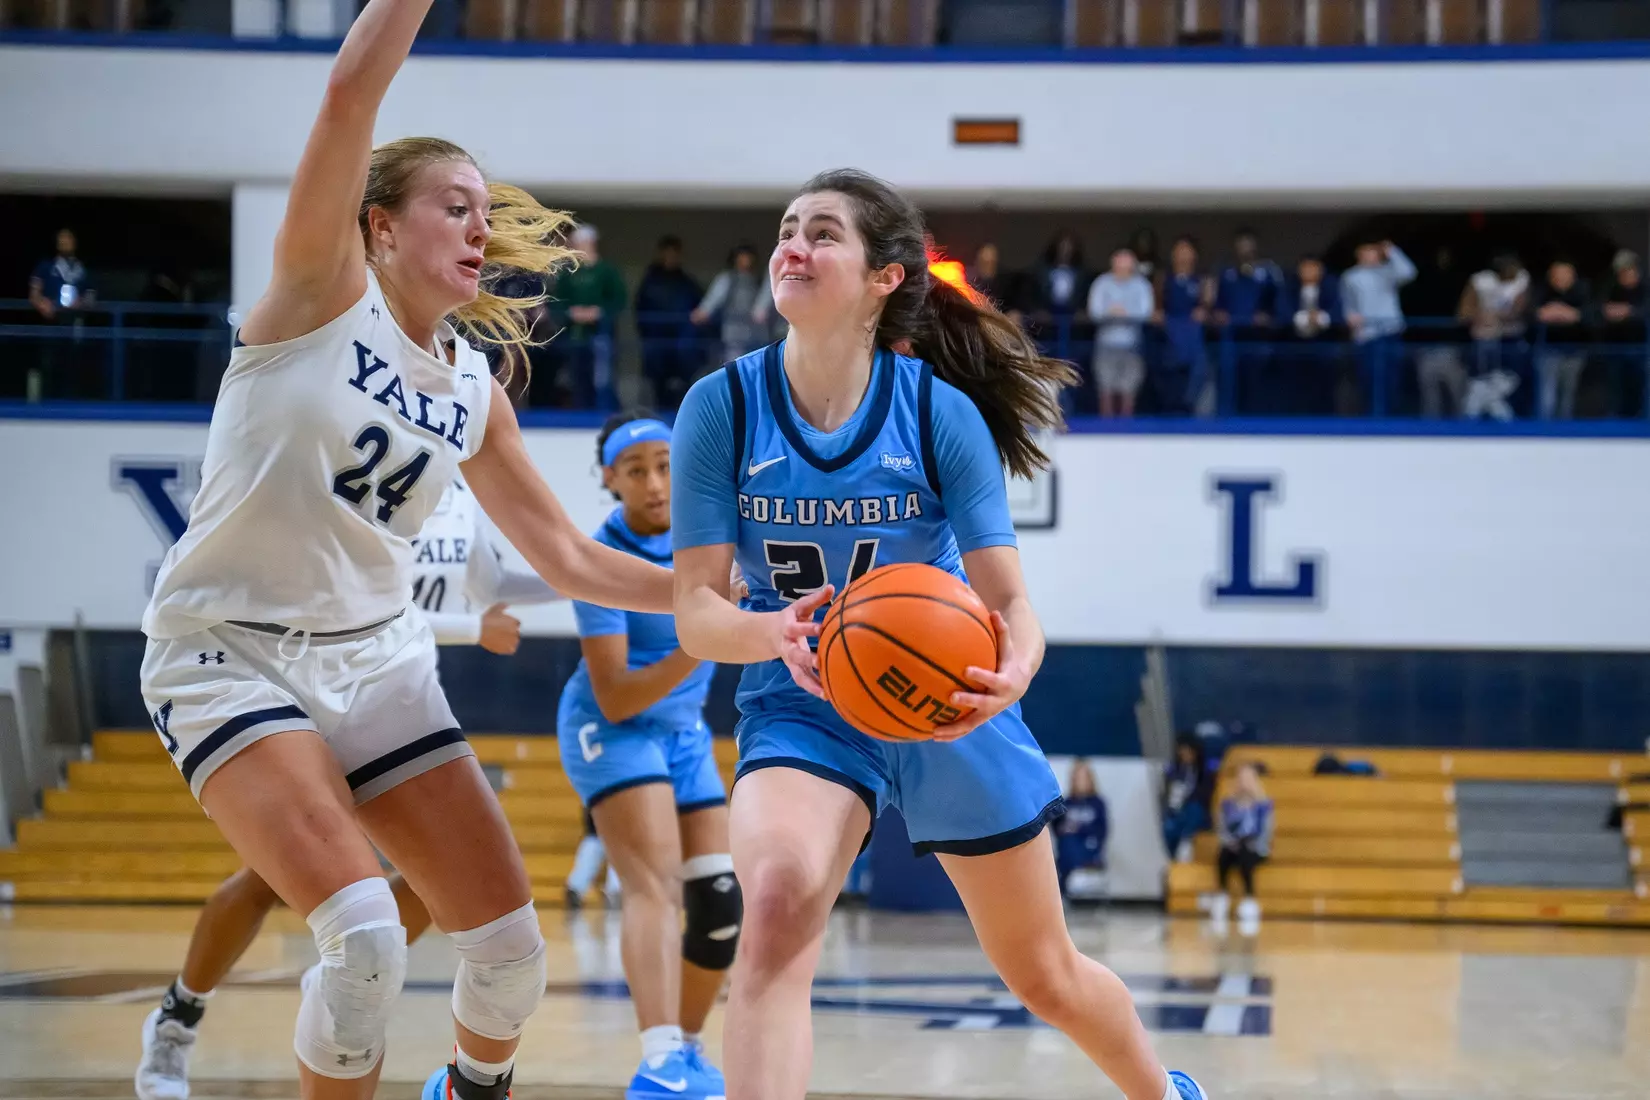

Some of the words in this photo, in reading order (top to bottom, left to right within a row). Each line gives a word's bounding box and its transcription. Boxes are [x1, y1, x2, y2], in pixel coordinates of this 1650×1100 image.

[347, 339, 469, 452] YALE
[331, 421, 434, 526] 24
[738, 491, 923, 526] COLUMBIA
[410, 537, 467, 563] ALE
[1202, 468, 1328, 611] L
[876, 664, 961, 726] ELITE
[152, 698, 180, 757] Y
[578, 721, 604, 763] C
